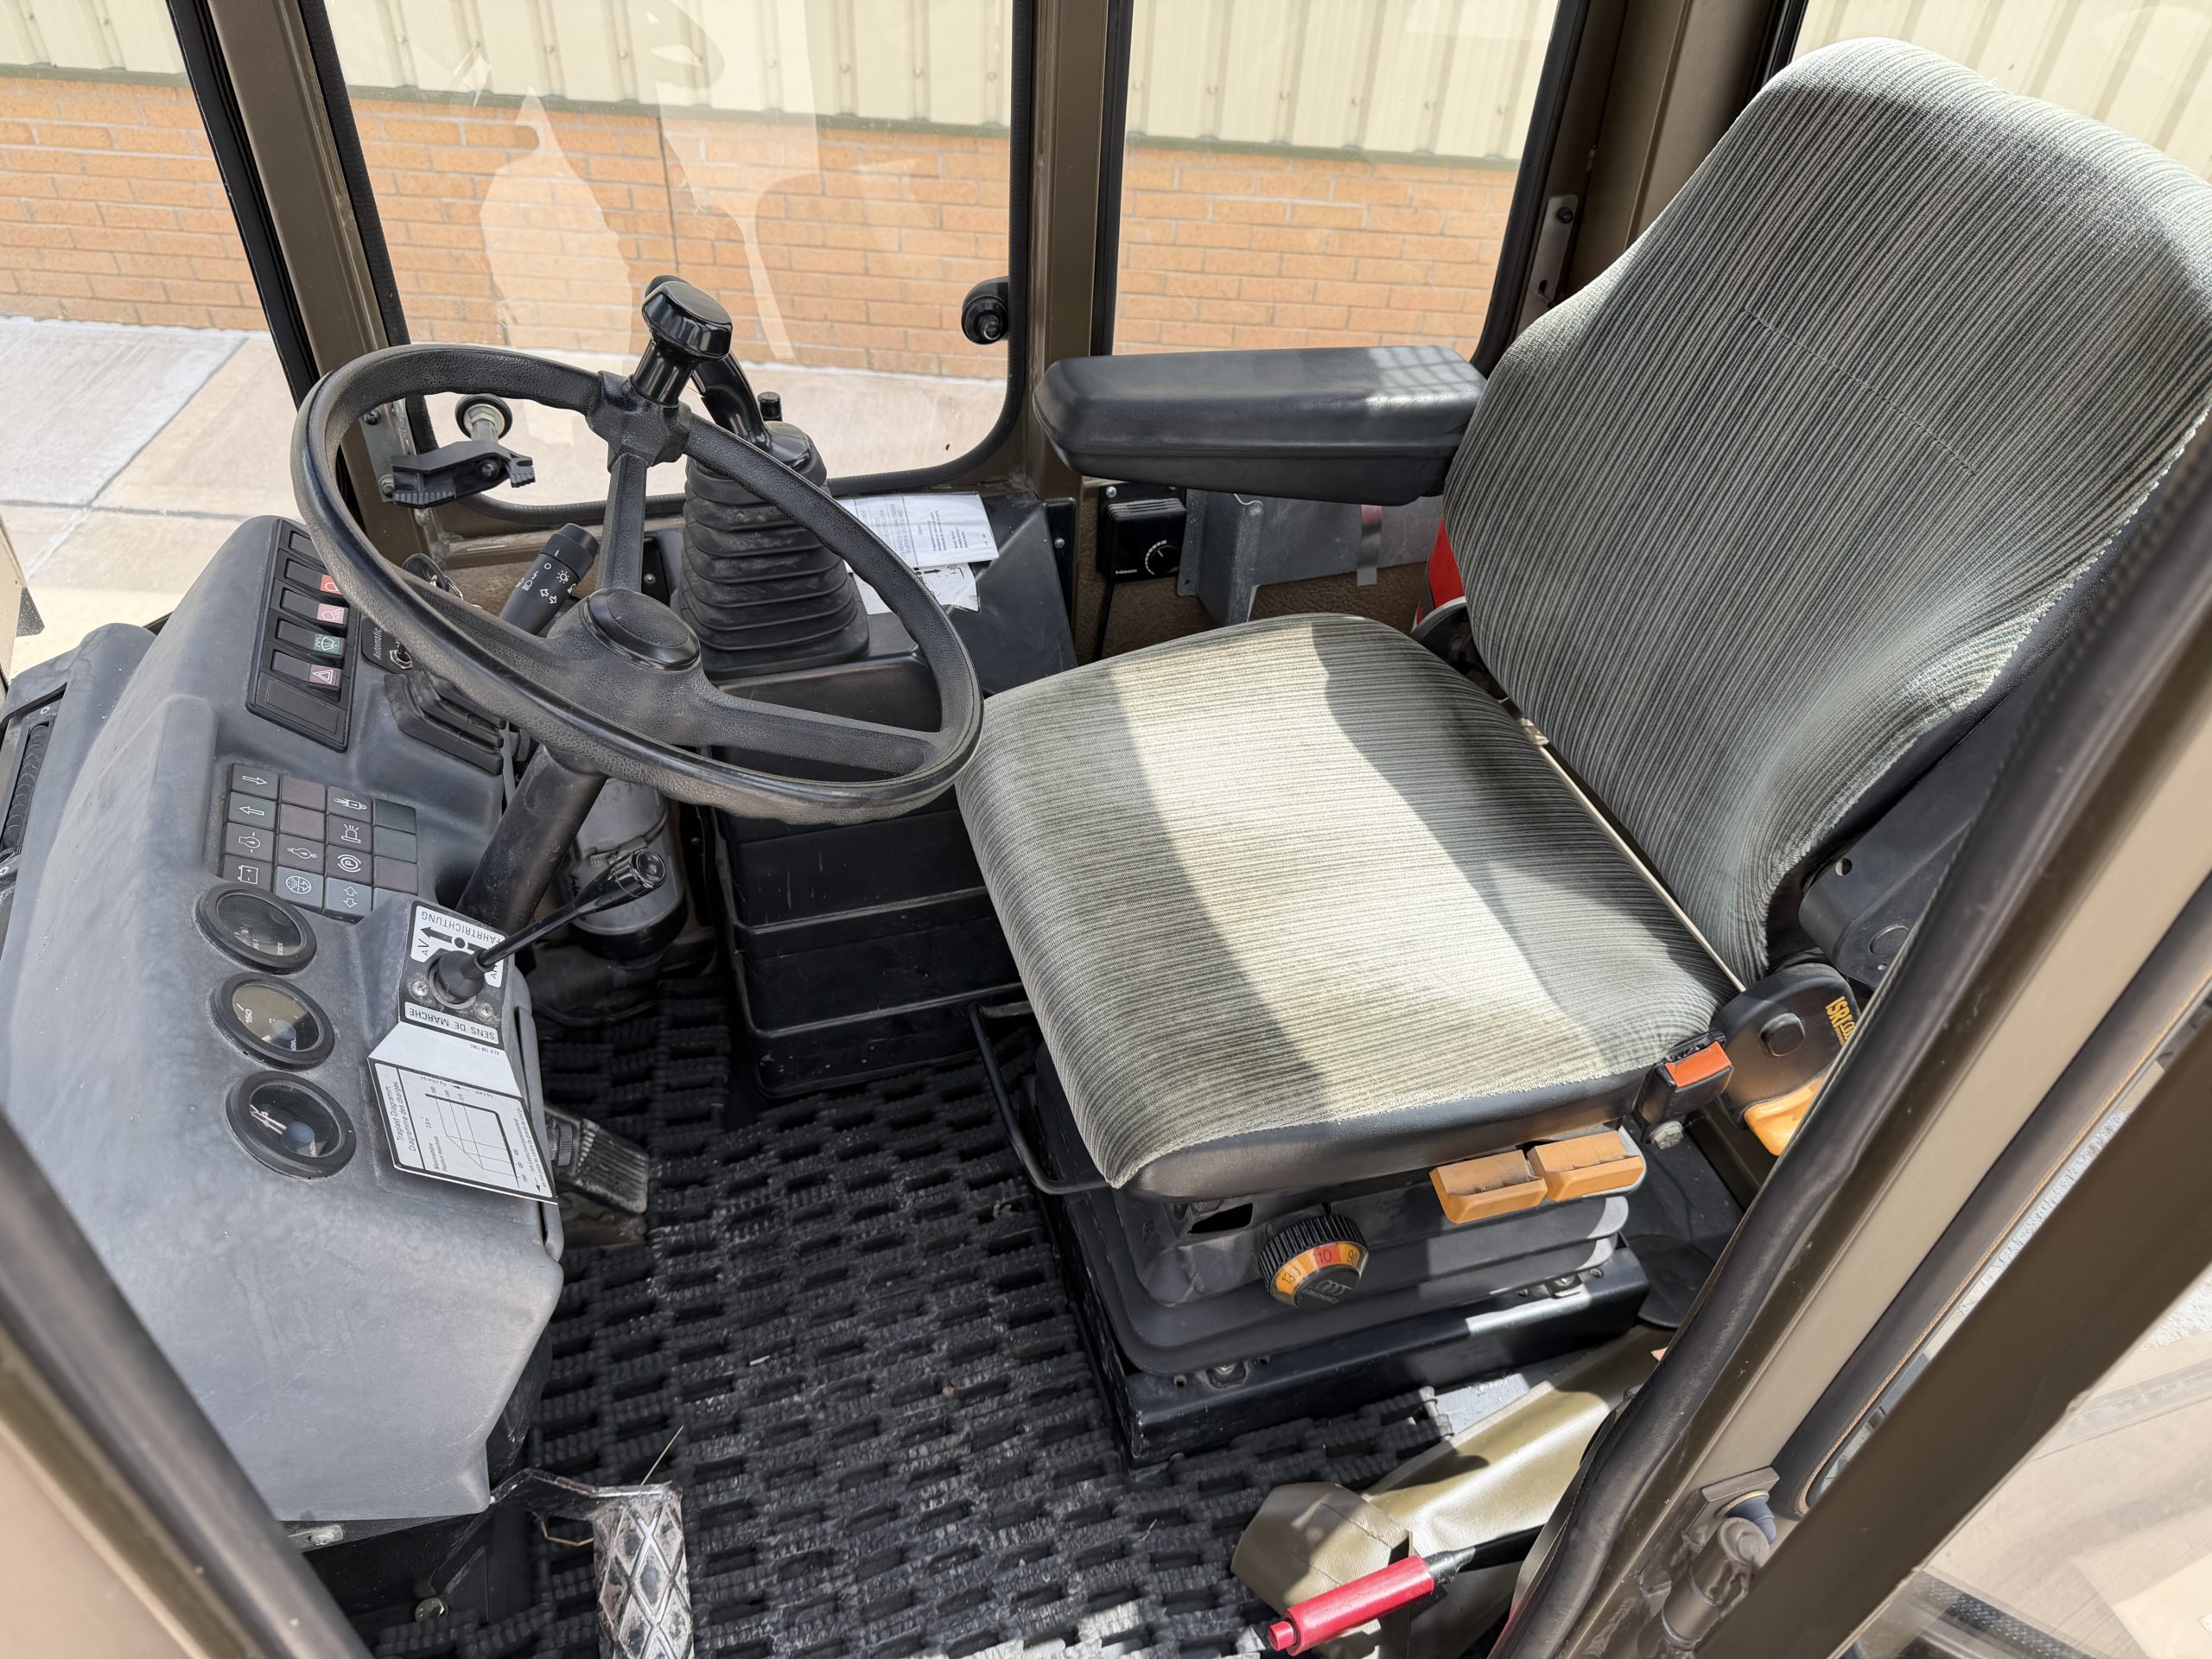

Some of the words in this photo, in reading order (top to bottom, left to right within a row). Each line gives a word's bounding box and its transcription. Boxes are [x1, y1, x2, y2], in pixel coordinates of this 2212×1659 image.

[372, 626, 382, 661] Automatic
[422, 911, 500, 944] FAHRTRICHTUNG
[417, 938, 429, 957] AV
[245, 1008, 253, 1024] 150
[409, 1007, 449, 1027] MARCHE
[1825, 995, 1853, 1028] ISRI
[454, 1021, 467, 1031] DE
[471, 1027, 495, 1040] SENS
[392, 1081, 404, 1104] charges
[398, 1104, 407, 1115] des
[402, 1116, 416, 1151] Diagramme
[1318, 1249, 1332, 1264] 10
[1346, 1249, 1357, 1266] 90
[1281, 1265, 1301, 1285] 130
